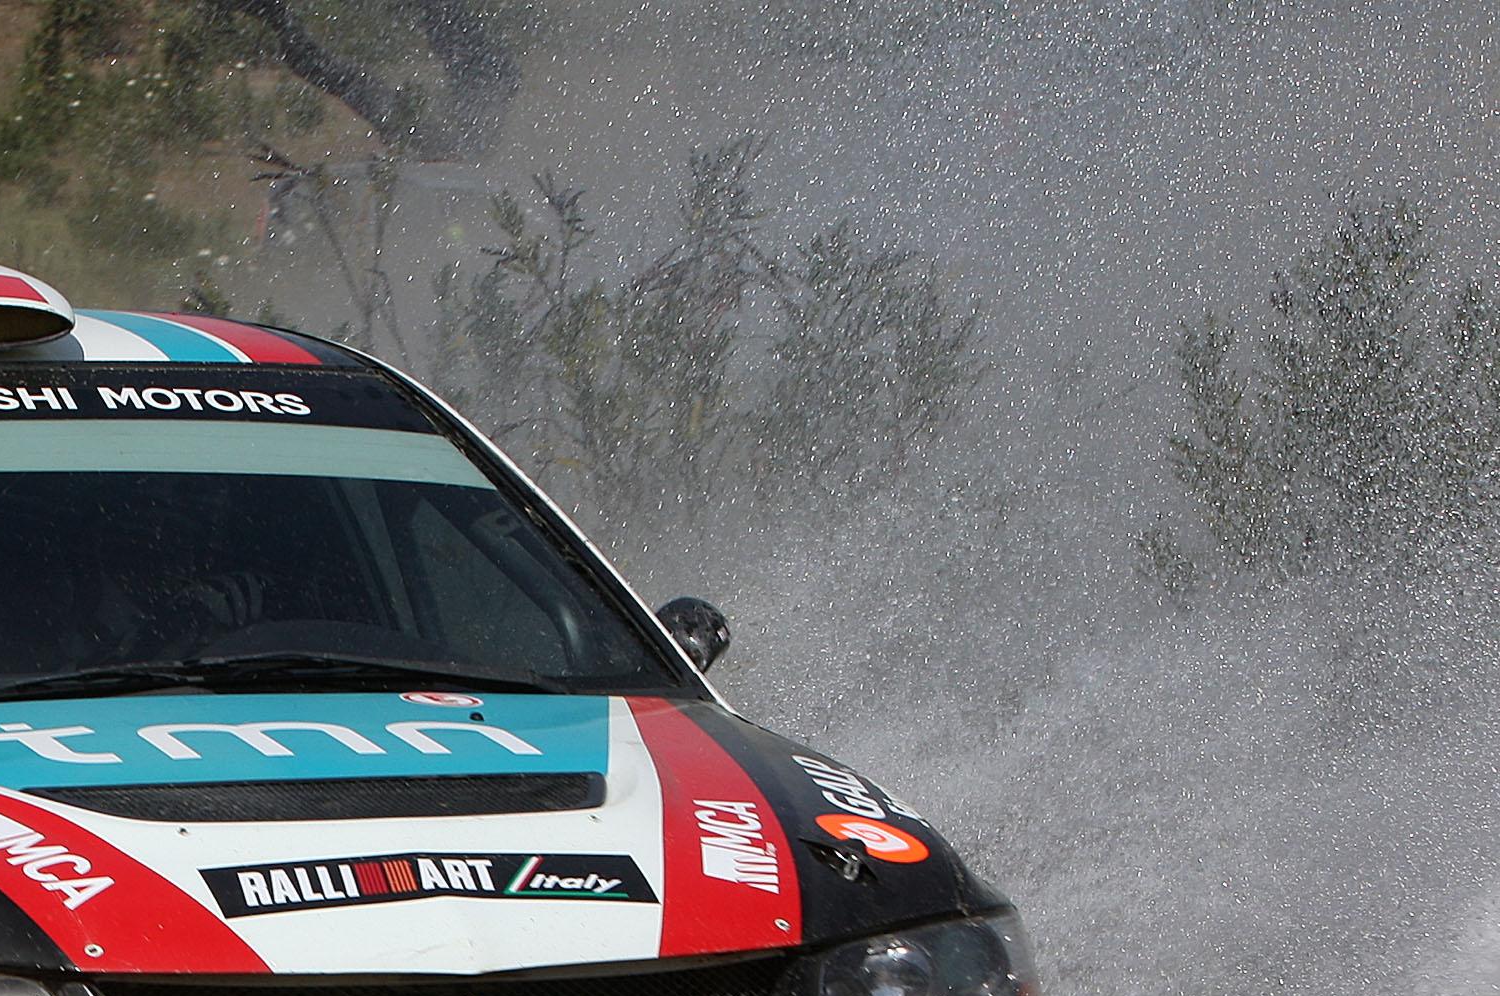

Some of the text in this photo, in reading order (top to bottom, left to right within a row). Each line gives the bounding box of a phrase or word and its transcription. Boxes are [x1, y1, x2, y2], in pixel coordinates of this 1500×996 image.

[99, 386, 312, 416] MOTORS
[236, 858, 625, 907] RALLI ART Italy
